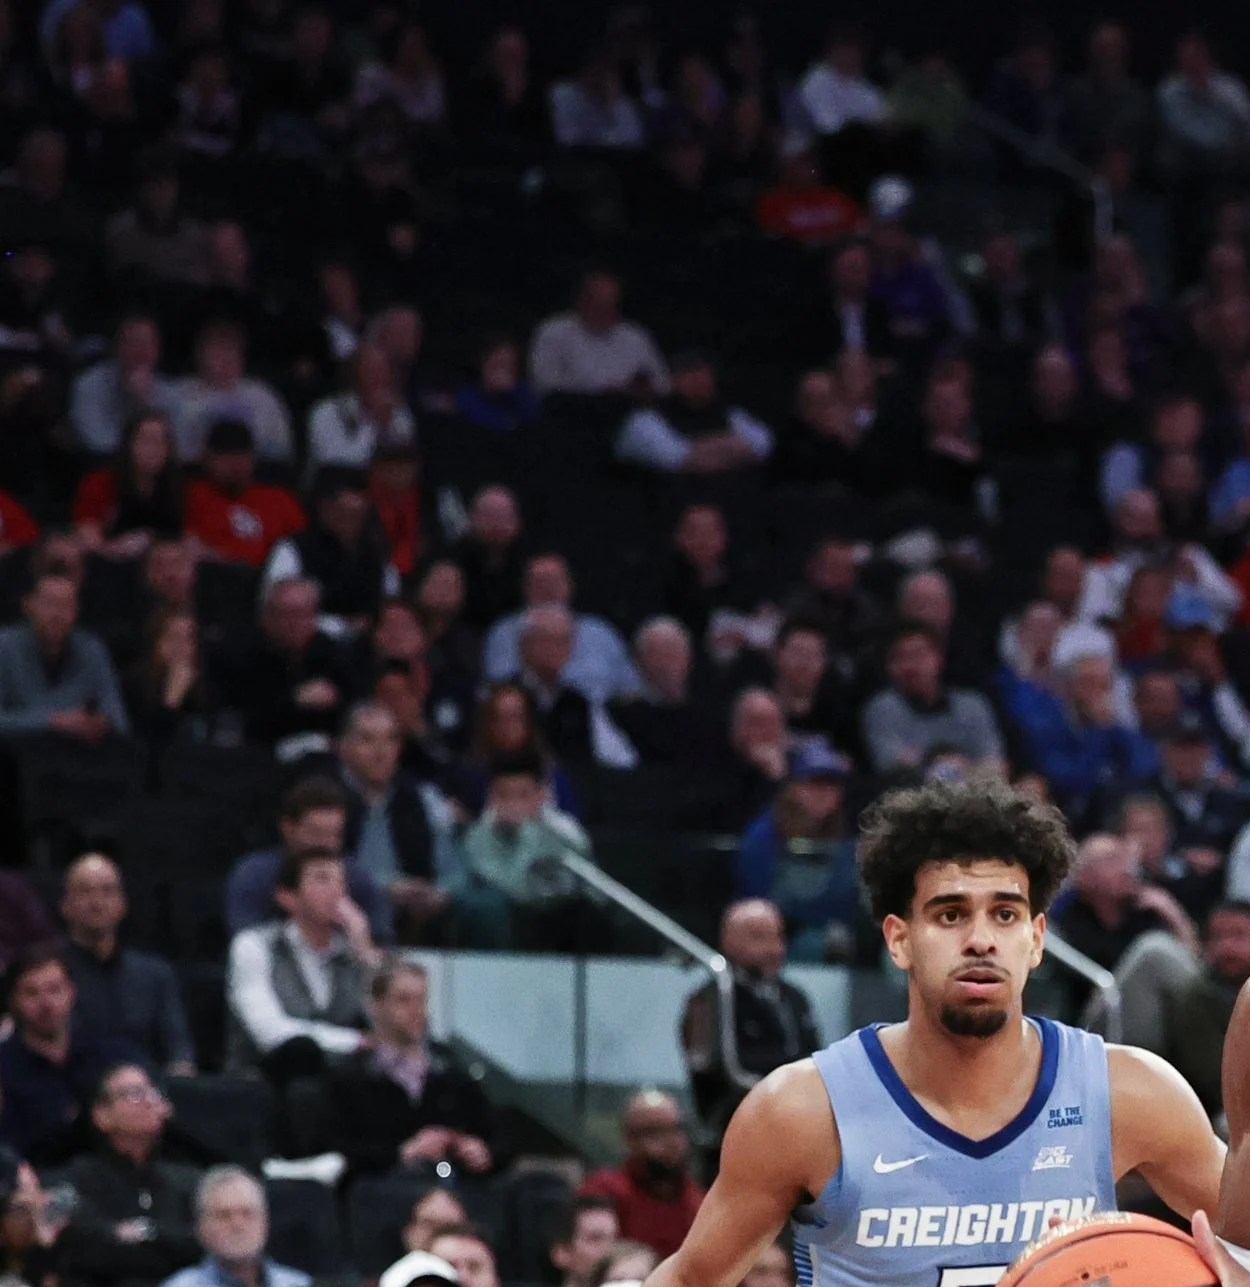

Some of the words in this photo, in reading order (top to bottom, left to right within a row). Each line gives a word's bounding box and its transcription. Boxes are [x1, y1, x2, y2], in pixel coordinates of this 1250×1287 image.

[1049, 1108, 1062, 1119] BE
[1065, 1106, 1080, 1117] THE
[1047, 1115, 1083, 1128] CHANGE
